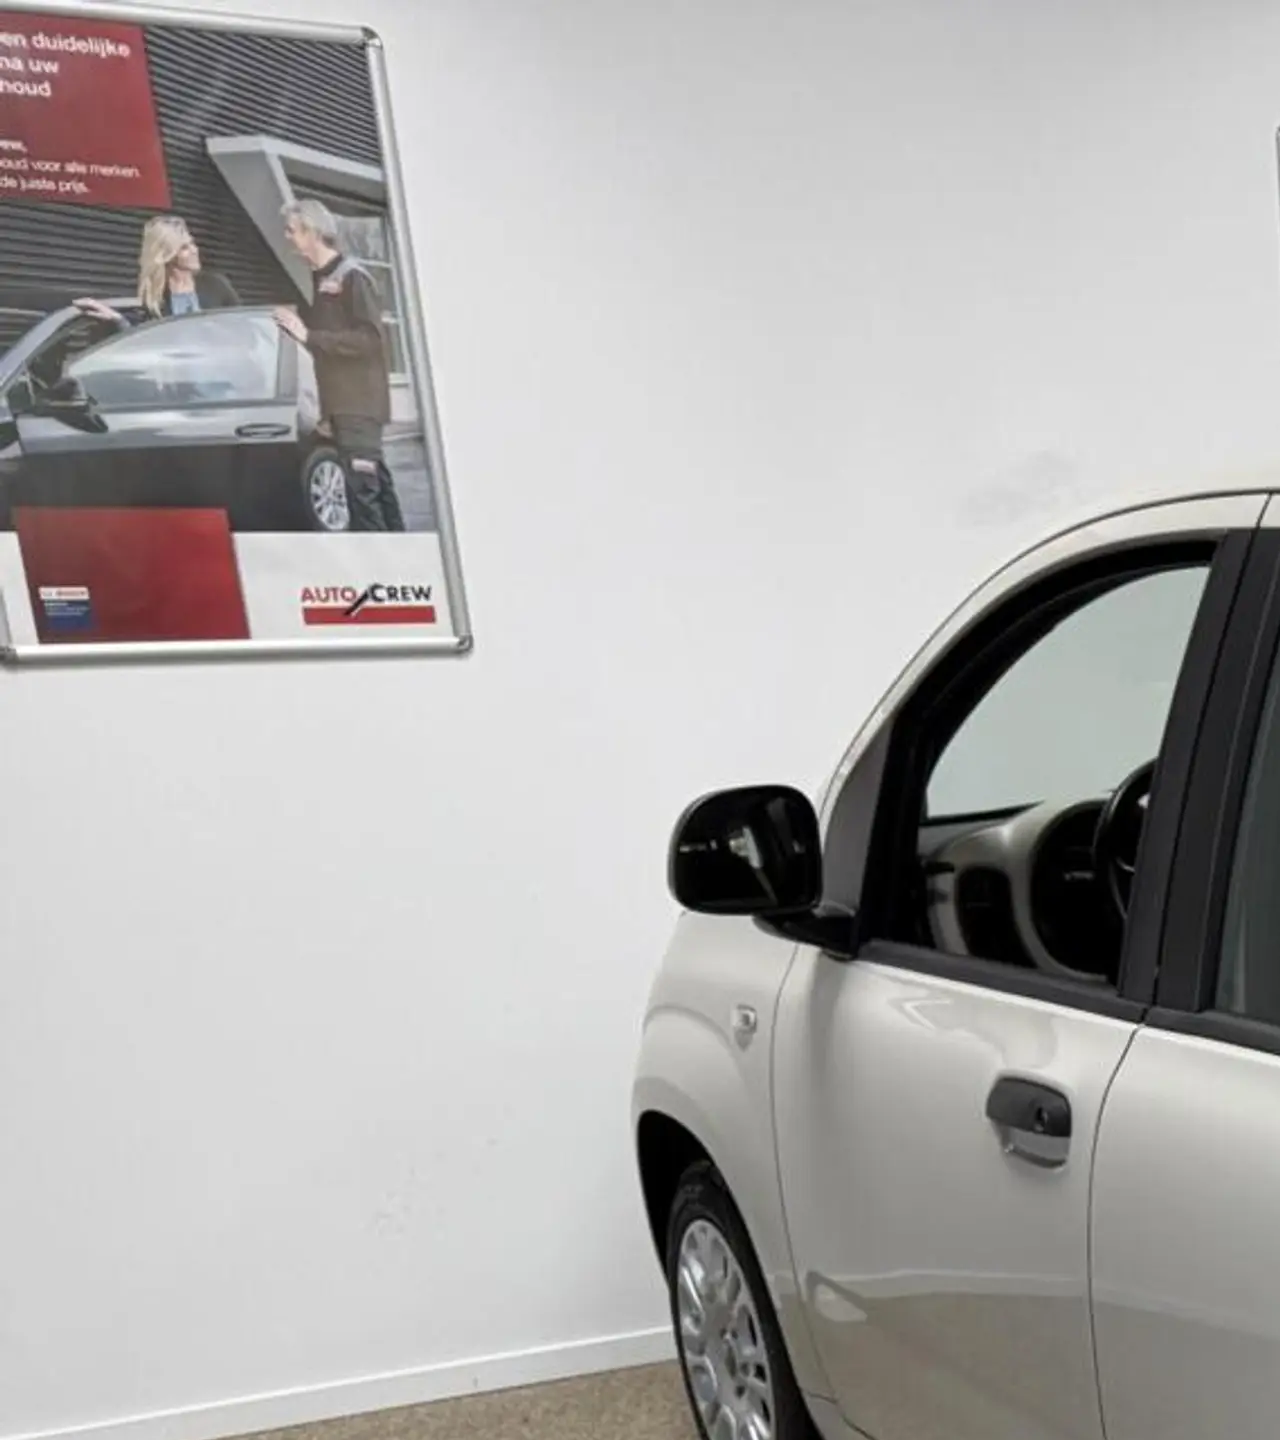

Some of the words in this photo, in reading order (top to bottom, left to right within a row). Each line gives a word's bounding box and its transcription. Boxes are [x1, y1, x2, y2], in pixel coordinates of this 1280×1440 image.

[31, 31, 131, 58] duidelijke
[28, 58, 59, 73] uw
[31, 160, 61, 172] voor
[64, 160, 87, 175] alle
